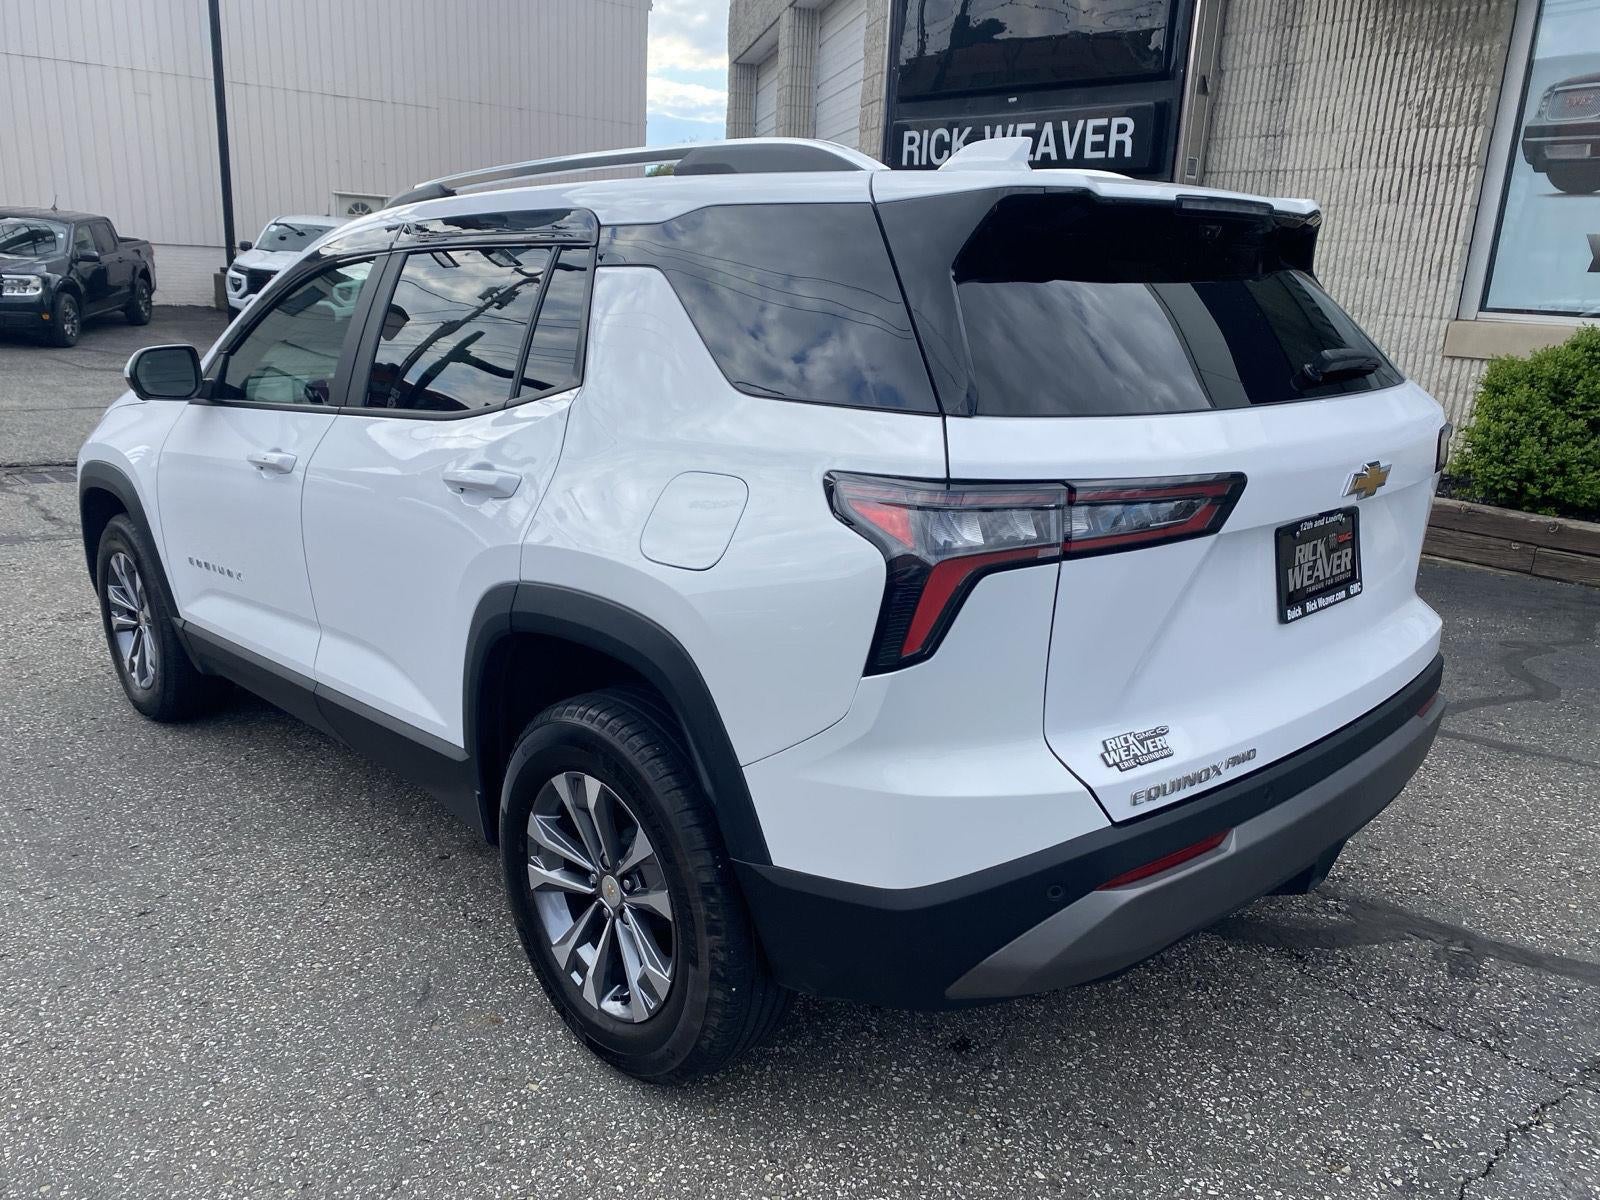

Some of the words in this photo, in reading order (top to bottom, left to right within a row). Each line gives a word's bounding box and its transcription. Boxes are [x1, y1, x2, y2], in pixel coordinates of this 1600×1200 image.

[1314, 517, 1325, 528] and
[1294, 537, 1326, 567] RICK
[1287, 548, 1352, 592] WEAVER
[1287, 605, 1302, 620] Buick
[1306, 599, 1318, 613] Rick
[1318, 590, 1346, 608] Weaver.com
[1350, 582, 1361, 595] GMC
[1105, 732, 1135, 751] RICK
[1135, 729, 1157, 740] GMC
[1103, 736, 1168, 765] WEAVER
[1119, 758, 1137, 770] ERIE
[1130, 761, 1224, 806] EQUINOX
